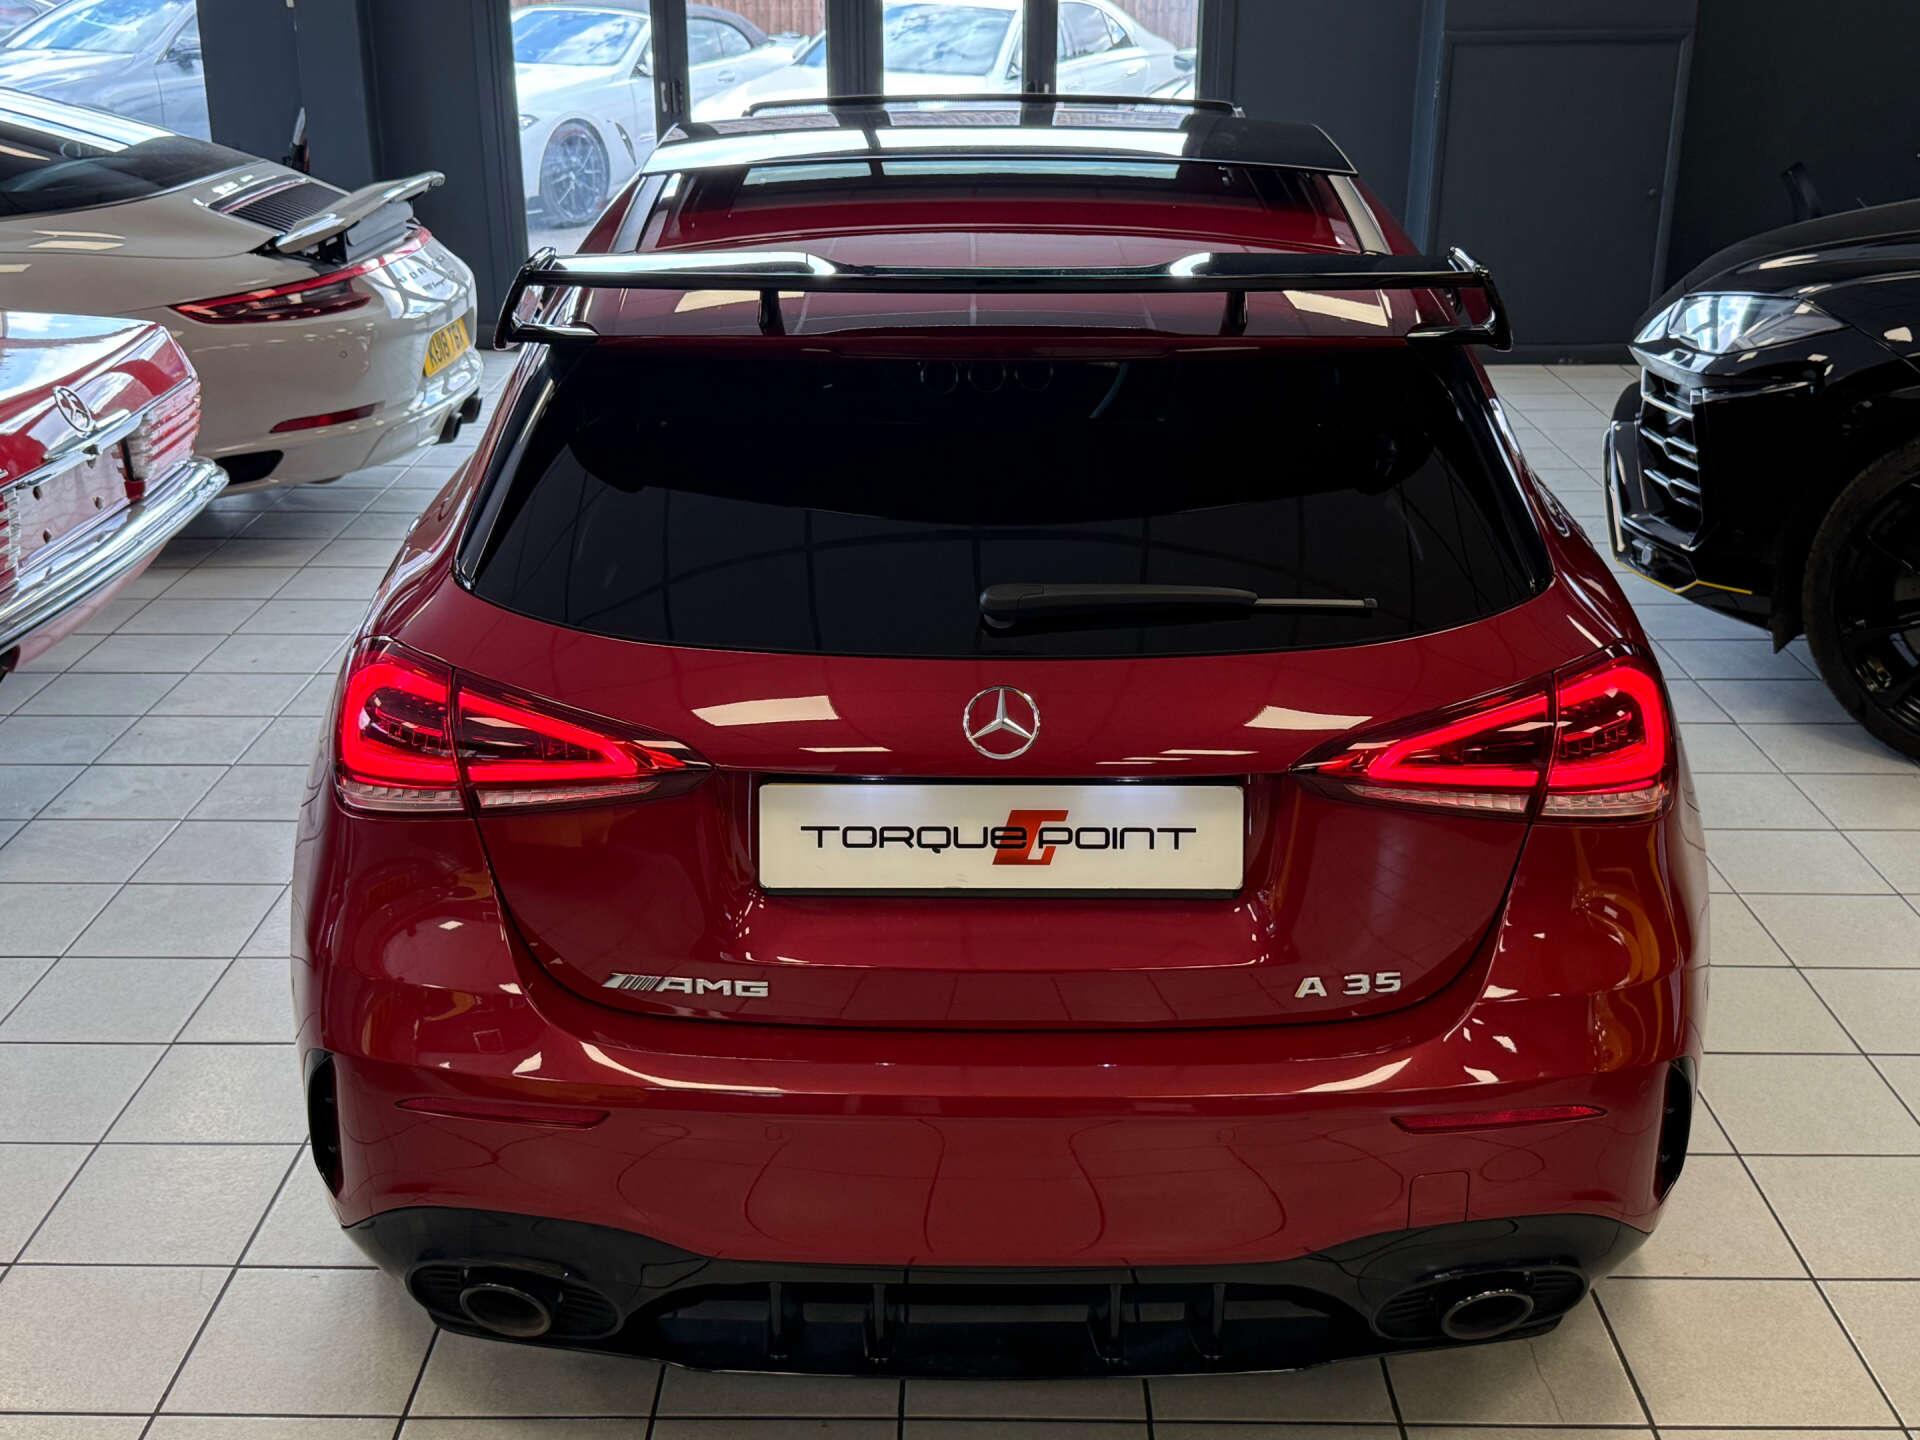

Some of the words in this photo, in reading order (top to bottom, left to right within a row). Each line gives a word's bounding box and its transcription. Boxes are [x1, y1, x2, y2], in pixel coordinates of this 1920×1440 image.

[800, 825, 1028, 854] TORQUE
[1038, 826, 1197, 850] POINT
[655, 975, 769, 998] AMG
[1294, 976, 1328, 999] A
[1342, 971, 1402, 996] 35
